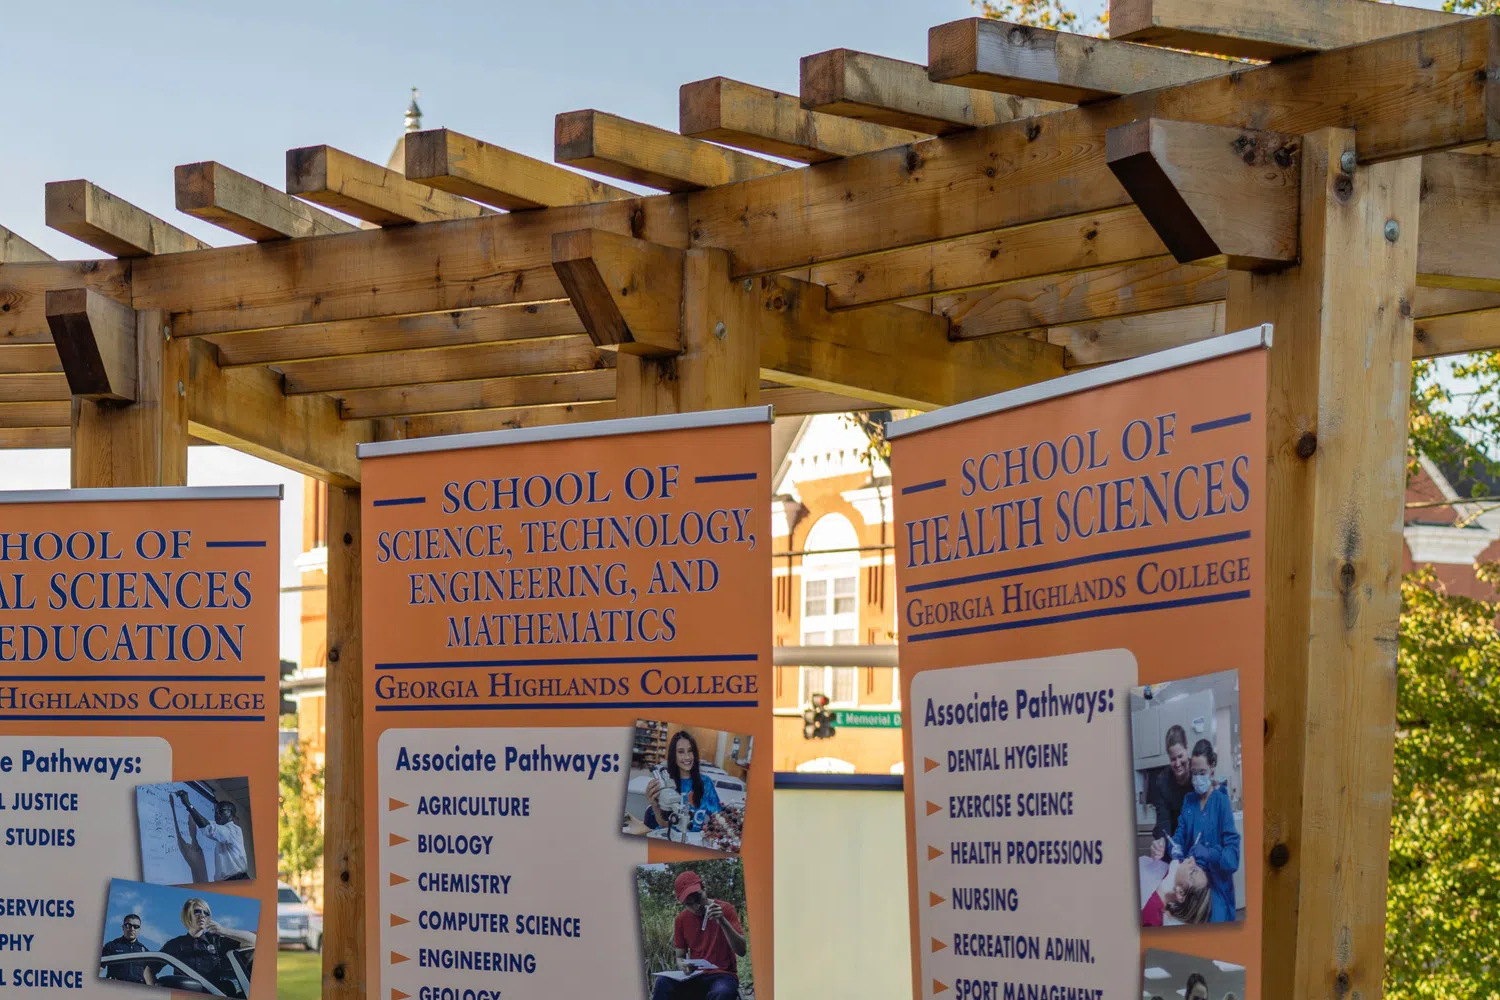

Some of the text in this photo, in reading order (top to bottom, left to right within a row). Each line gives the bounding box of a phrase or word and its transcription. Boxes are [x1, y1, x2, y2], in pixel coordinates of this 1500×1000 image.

[960, 413, 1177, 497] SCHOOL OF
[442, 464, 680, 515] SCHOOL OF
[906, 455, 1250, 568] HEALTH SCIENCES
[135, 530, 191, 560] OF
[377, 508, 757, 564] SCIENCE, TECHNOLOGY,
[48, 570, 251, 610] SCIENCES
[409, 558, 719, 605] ENGINEERING, AND
[447, 607, 676, 648] MATHEMATICS
[837, 713, 843, 724] E
[846, 713, 890, 725] Memorial
[924, 686, 1113, 726] Associate Pathways:
[22, 747, 141, 780] Pathways:
[395, 743, 619, 780] Associate Pathways:
[947, 743, 1067, 772] DENTAL HYGIENE
[11, 792, 78, 811] JUSTICE
[417, 795, 529, 816] AGRICULTURE
[949, 792, 1072, 818] EXERCISE SCIENCE
[5, 827, 75, 846] STUDIES
[417, 834, 492, 855] BIOLOGY
[951, 839, 1102, 864] HEALTH PROFESSIONS
[417, 872, 511, 894] CHEMISTRY
[952, 887, 1018, 911] NURSING
[418, 910, 580, 937] COMPUTER SCIENCE
[419, 948, 536, 973] ENGINEERING
[954, 933, 1095, 964] RECREATION ADMIN.
[12, 968, 82, 988] SCIENCE
